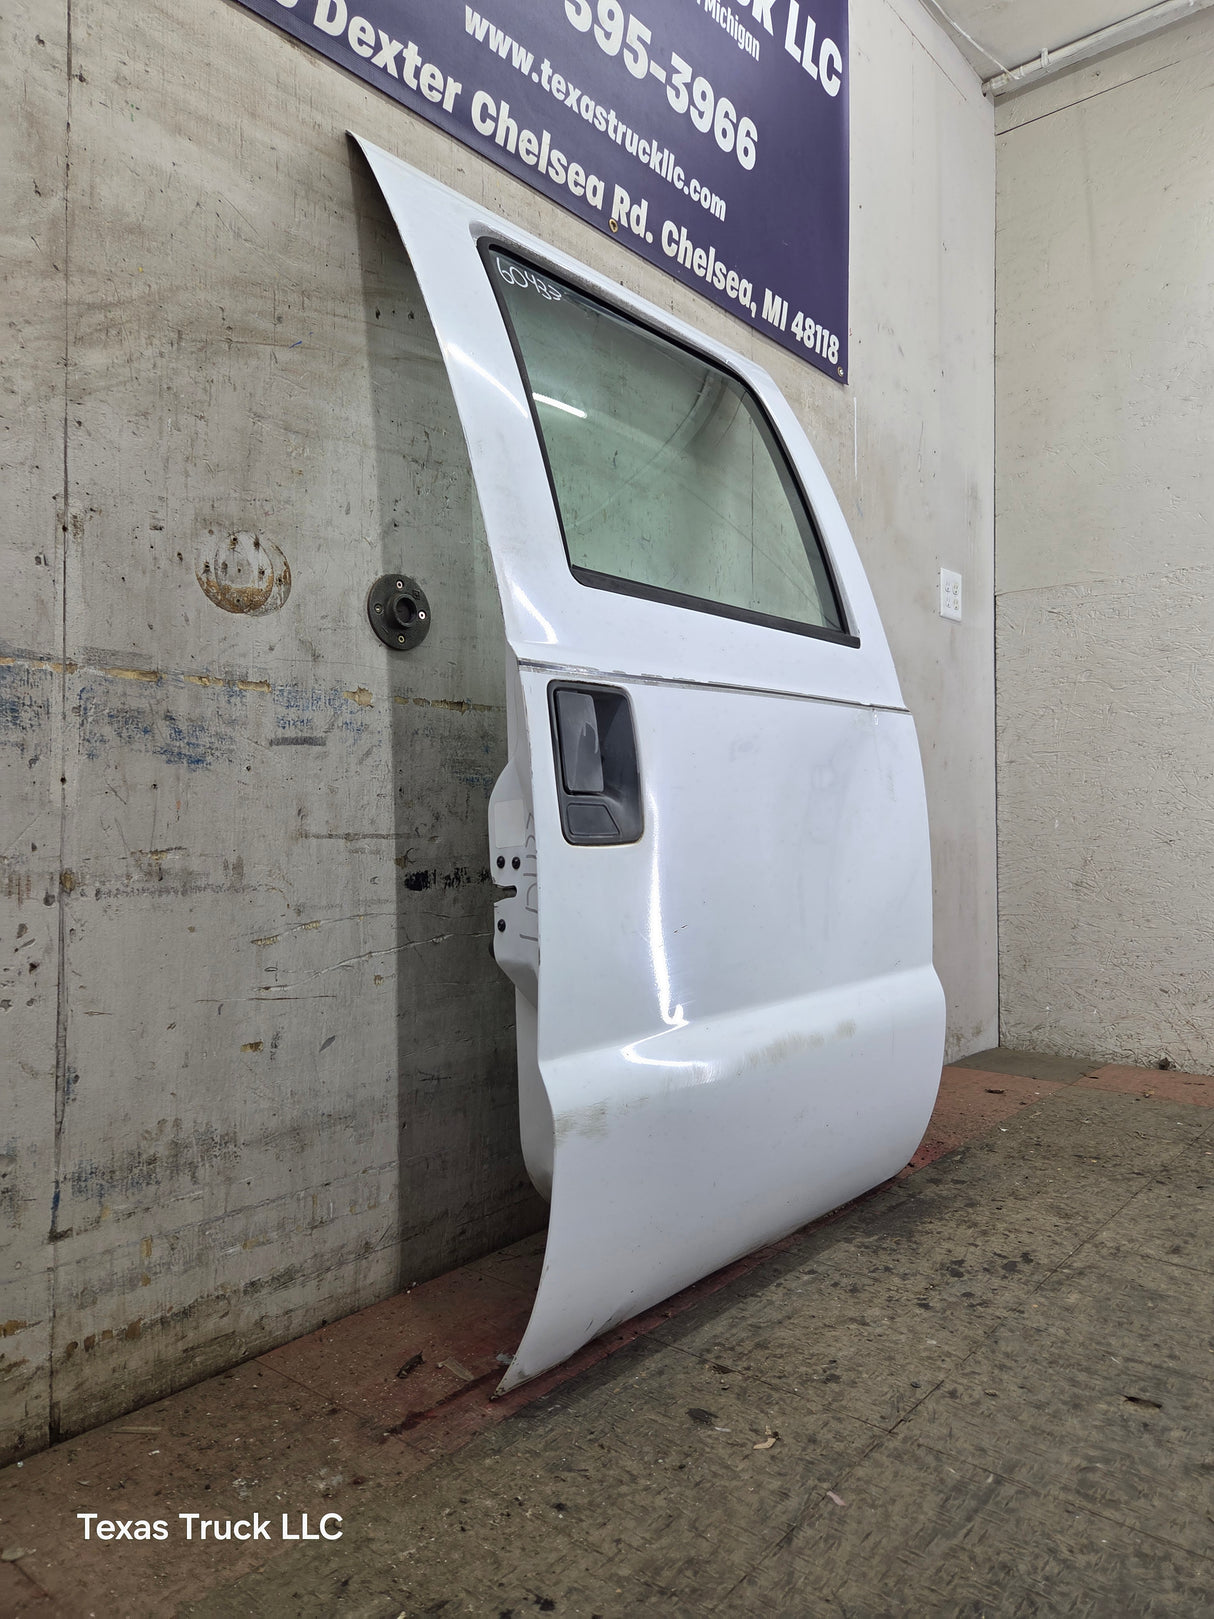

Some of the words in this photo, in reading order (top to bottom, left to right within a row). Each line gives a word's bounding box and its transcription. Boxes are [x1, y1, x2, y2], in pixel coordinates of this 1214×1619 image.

[703, 0, 761, 62] Michigan
[784, 0, 843, 97] LLC
[313, 0, 463, 113] Dexter
[471, 90, 605, 210] Chelsea
[611, 183, 654, 244] Rd.
[661, 220, 757, 318] Chelsea,
[761, 287, 789, 331] MI
[790, 311, 840, 365] 48118
[465, 4, 727, 222] www.texastruckllc.com
